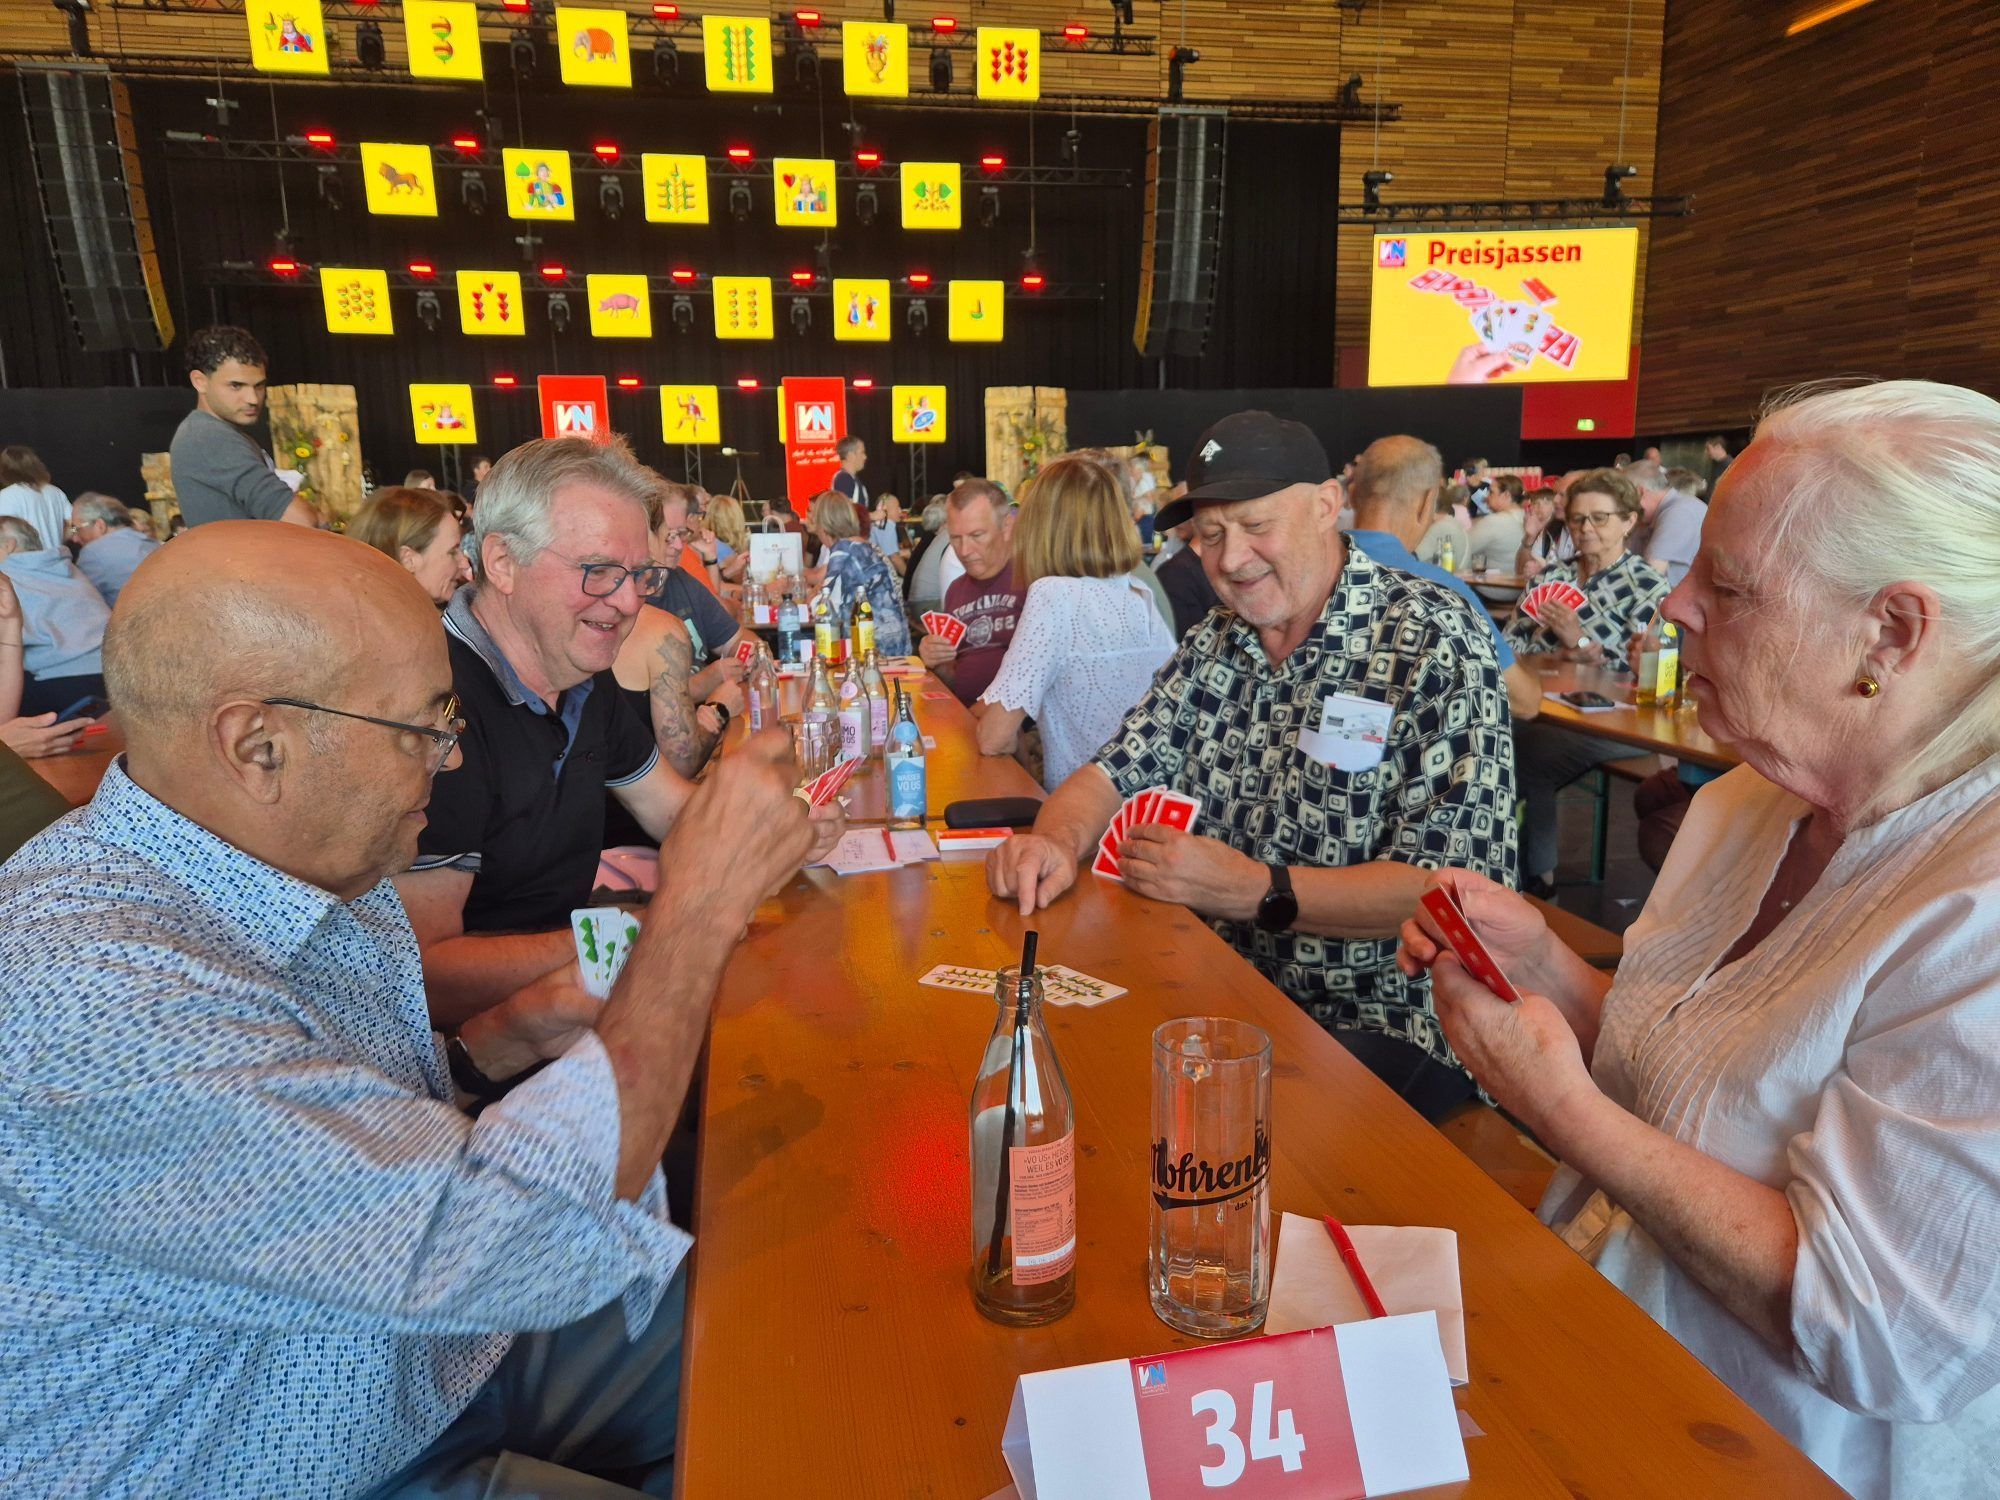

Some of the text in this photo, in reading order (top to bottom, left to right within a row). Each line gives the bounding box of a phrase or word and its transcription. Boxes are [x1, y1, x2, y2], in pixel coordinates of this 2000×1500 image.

[1428, 239, 1582, 269] Preisjassen
[897, 772, 921, 781] WASSER
[897, 781, 922, 791] VO US
[1026, 1164, 1044, 1173] WEIL
[1045, 1161, 1054, 1170] ES
[1191, 1380, 1306, 1487] 34
